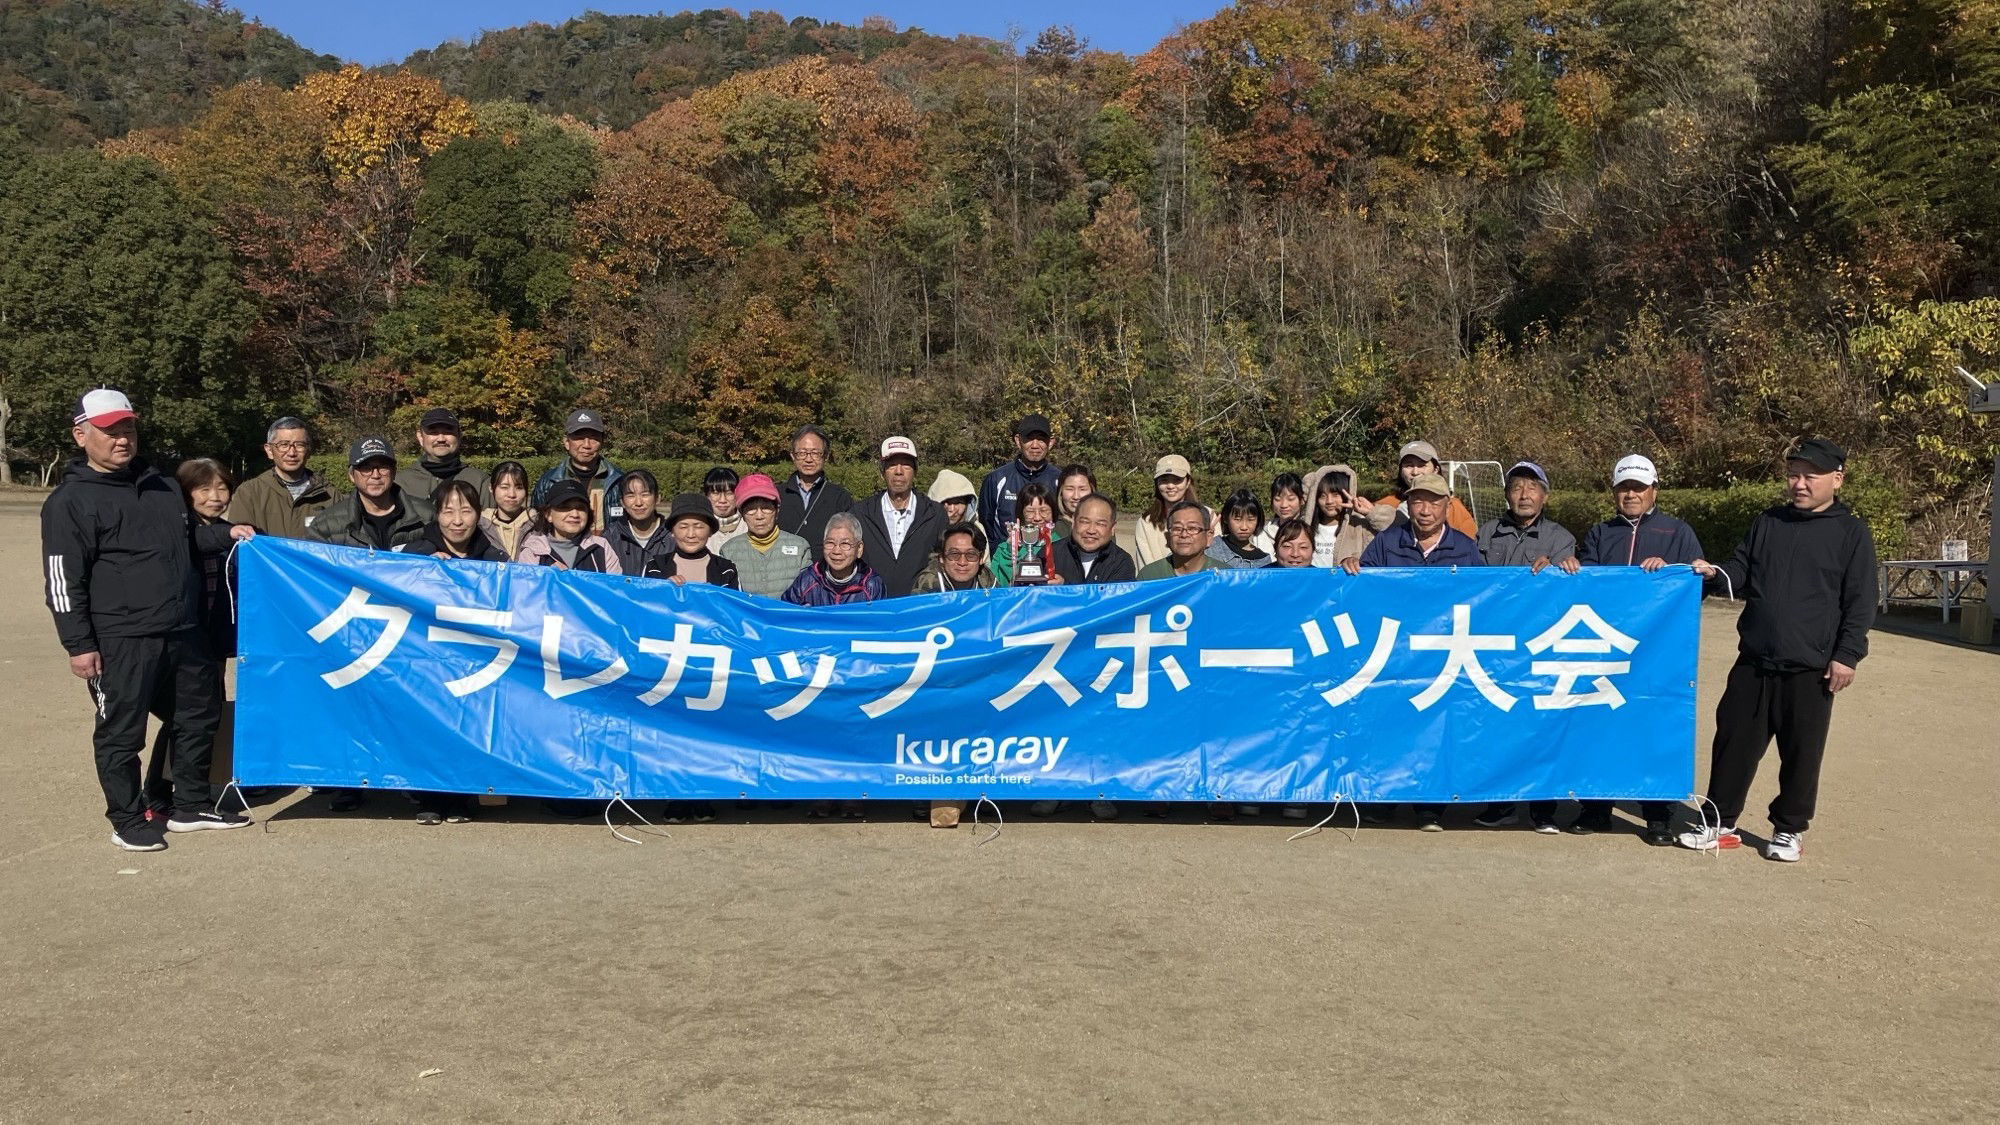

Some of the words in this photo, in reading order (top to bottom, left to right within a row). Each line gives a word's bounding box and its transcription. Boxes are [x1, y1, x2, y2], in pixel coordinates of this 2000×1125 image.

[896, 733, 1069, 773] kuraray
[895, 774, 953, 785] Possible
[956, 773, 997, 784] starts
[1000, 773, 1031, 784] here
